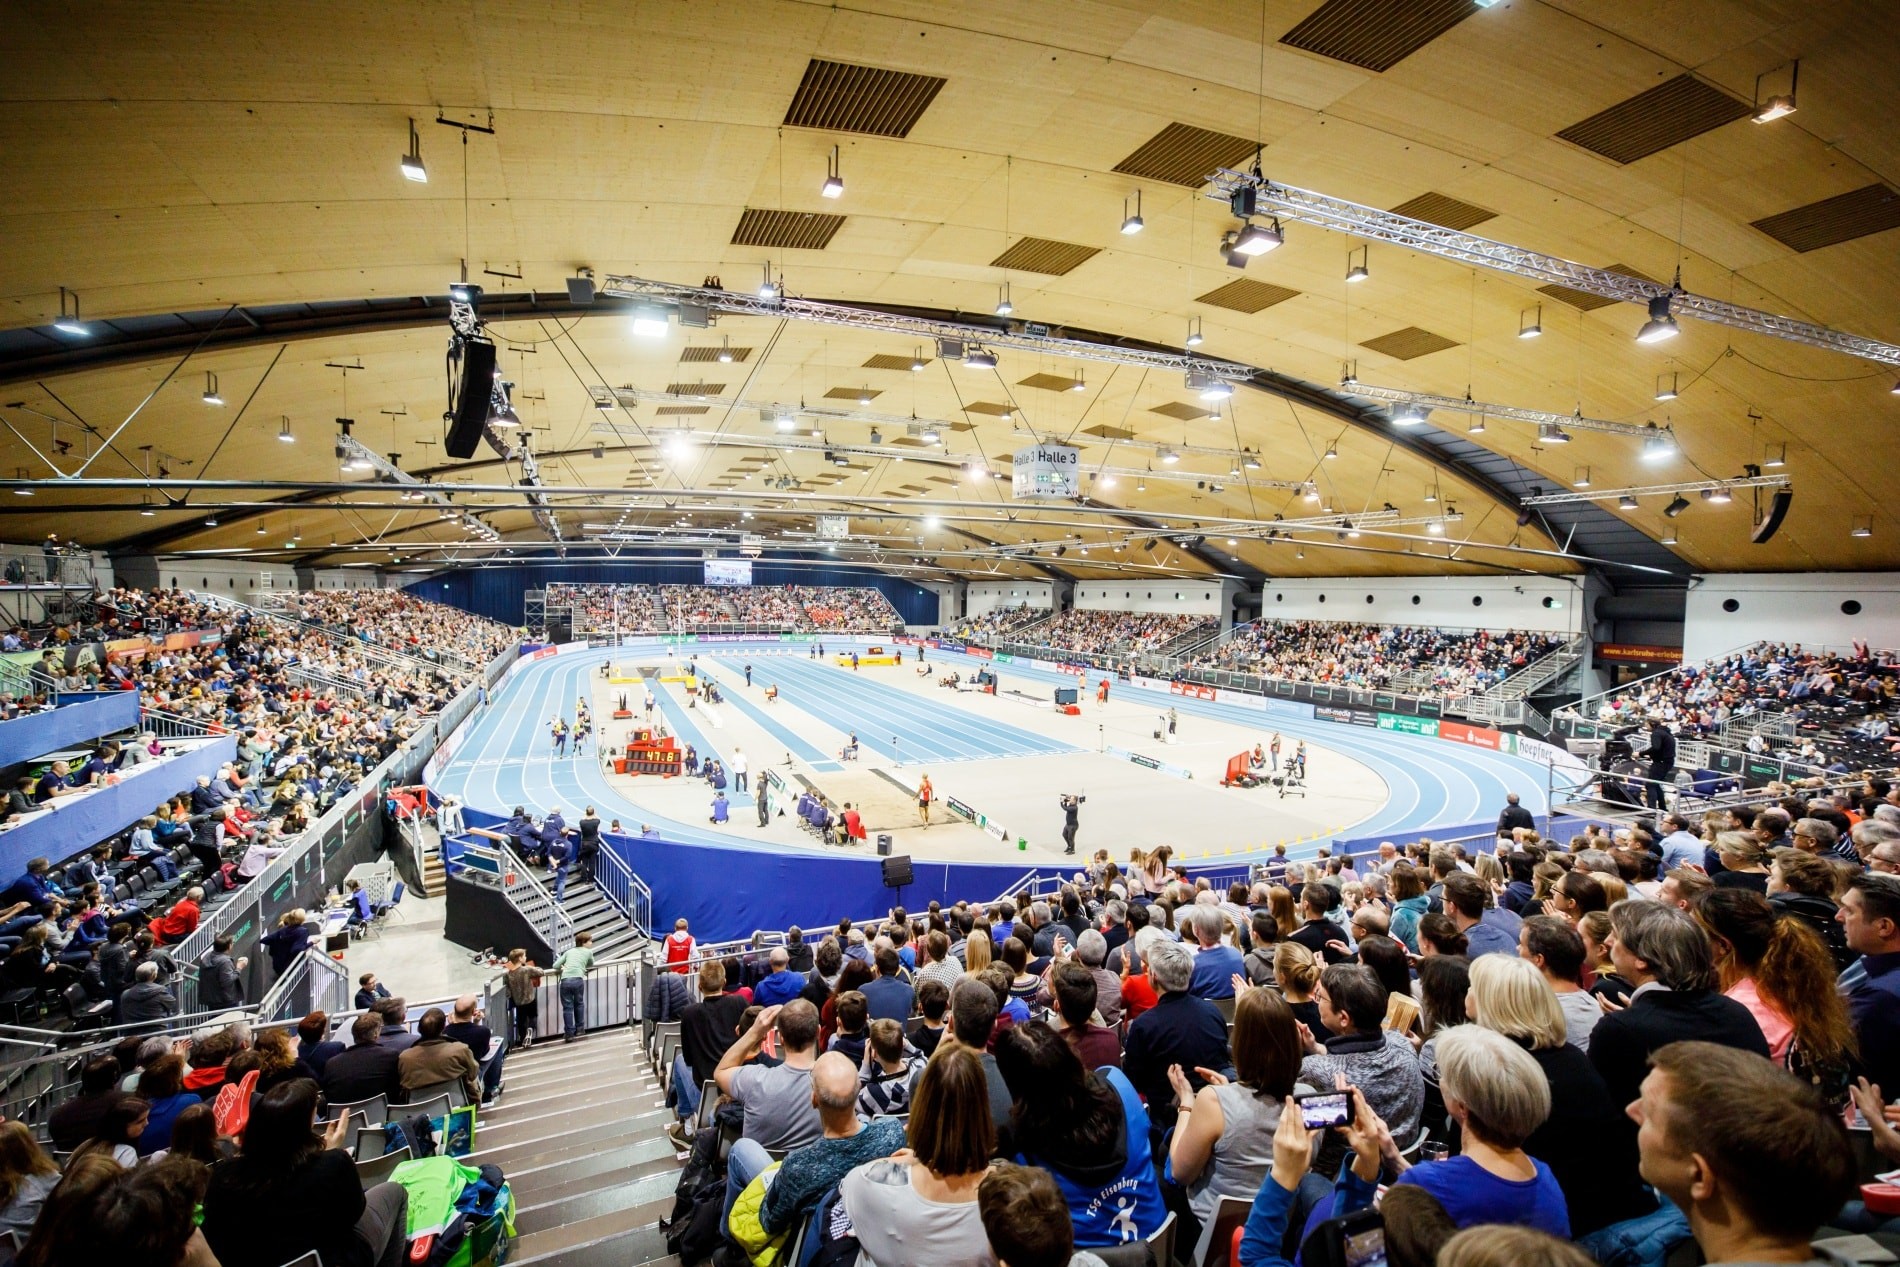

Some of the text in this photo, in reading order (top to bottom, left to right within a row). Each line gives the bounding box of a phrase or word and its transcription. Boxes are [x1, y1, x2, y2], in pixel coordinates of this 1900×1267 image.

[1014, 451, 1035, 466] Halle 3
[1038, 451, 1076, 464] Halle 3
[642, 732, 648, 741] 0
[1086, 1176, 1138, 1218] TSG Eisenberg
